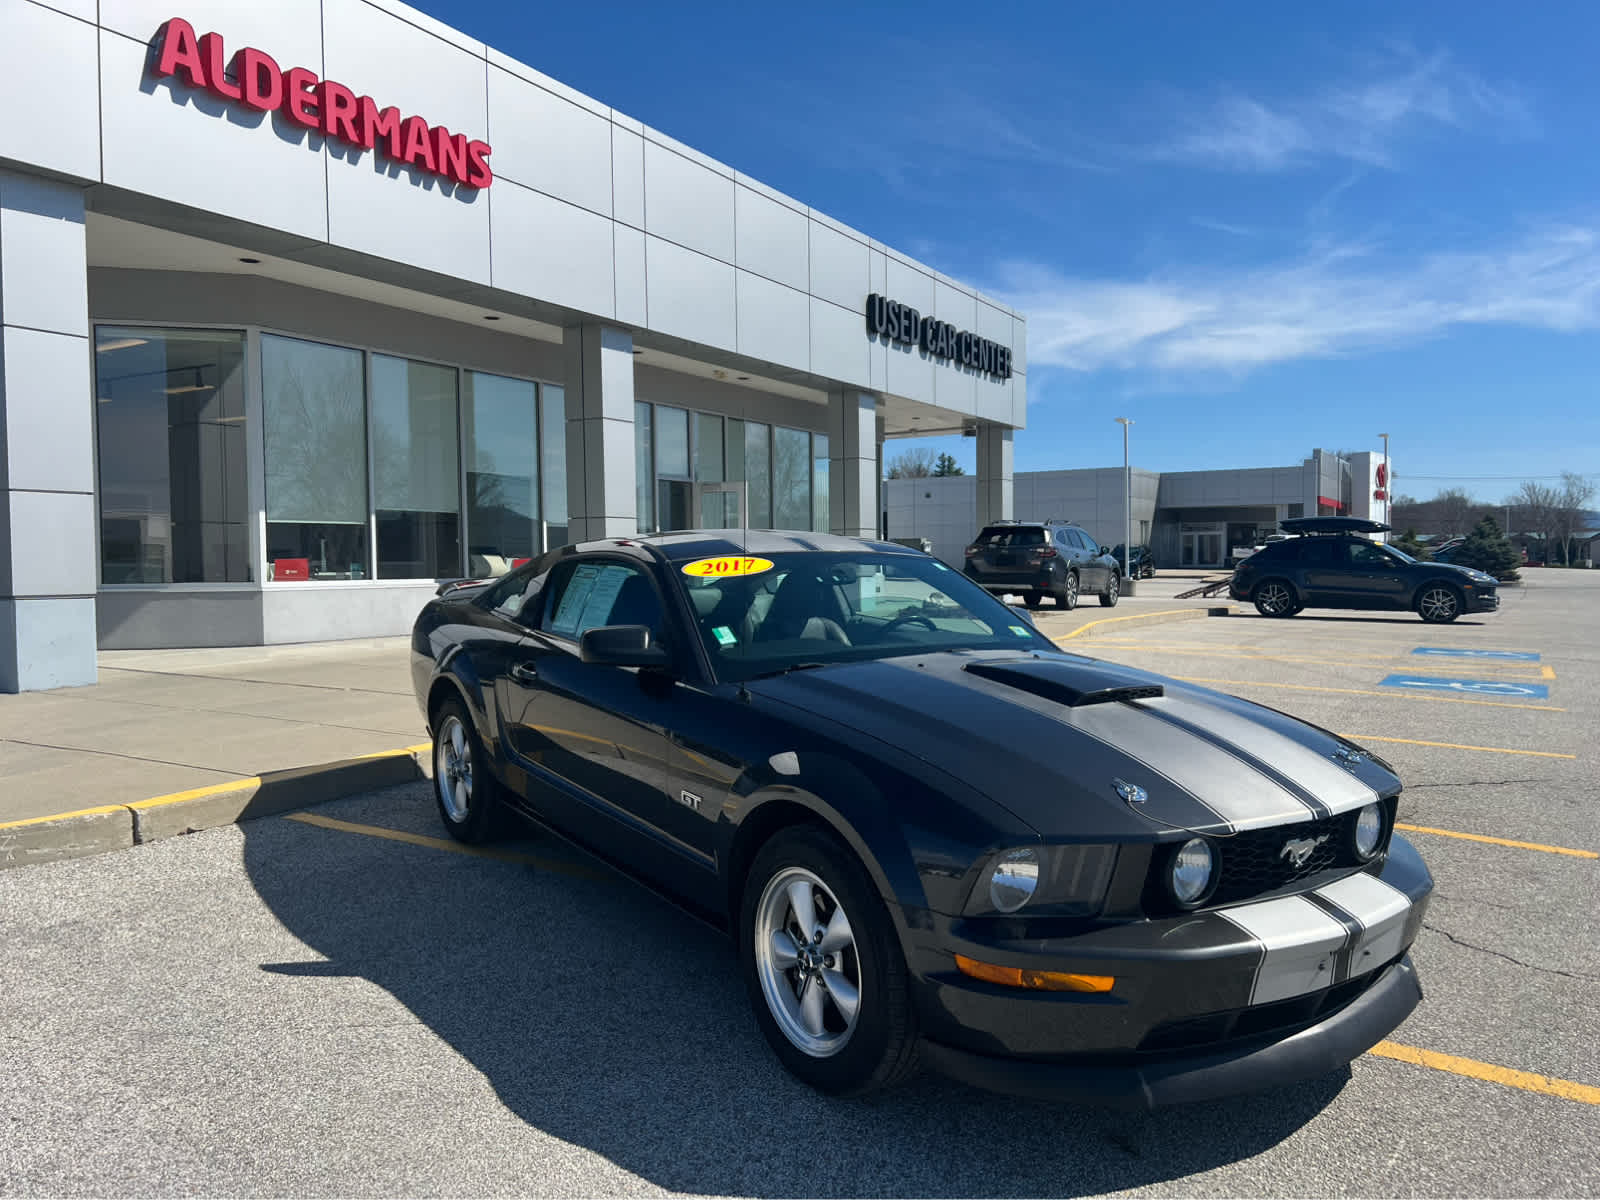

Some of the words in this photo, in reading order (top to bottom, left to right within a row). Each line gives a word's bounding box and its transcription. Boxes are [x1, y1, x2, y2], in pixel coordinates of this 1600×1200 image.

[158, 17, 492, 189] ALDERMANS
[869, 294, 921, 345] USED
[923, 315, 957, 360] CAR
[959, 330, 1012, 378] CENTER
[702, 559, 755, 574] 2017
[681, 790, 702, 809] GT
